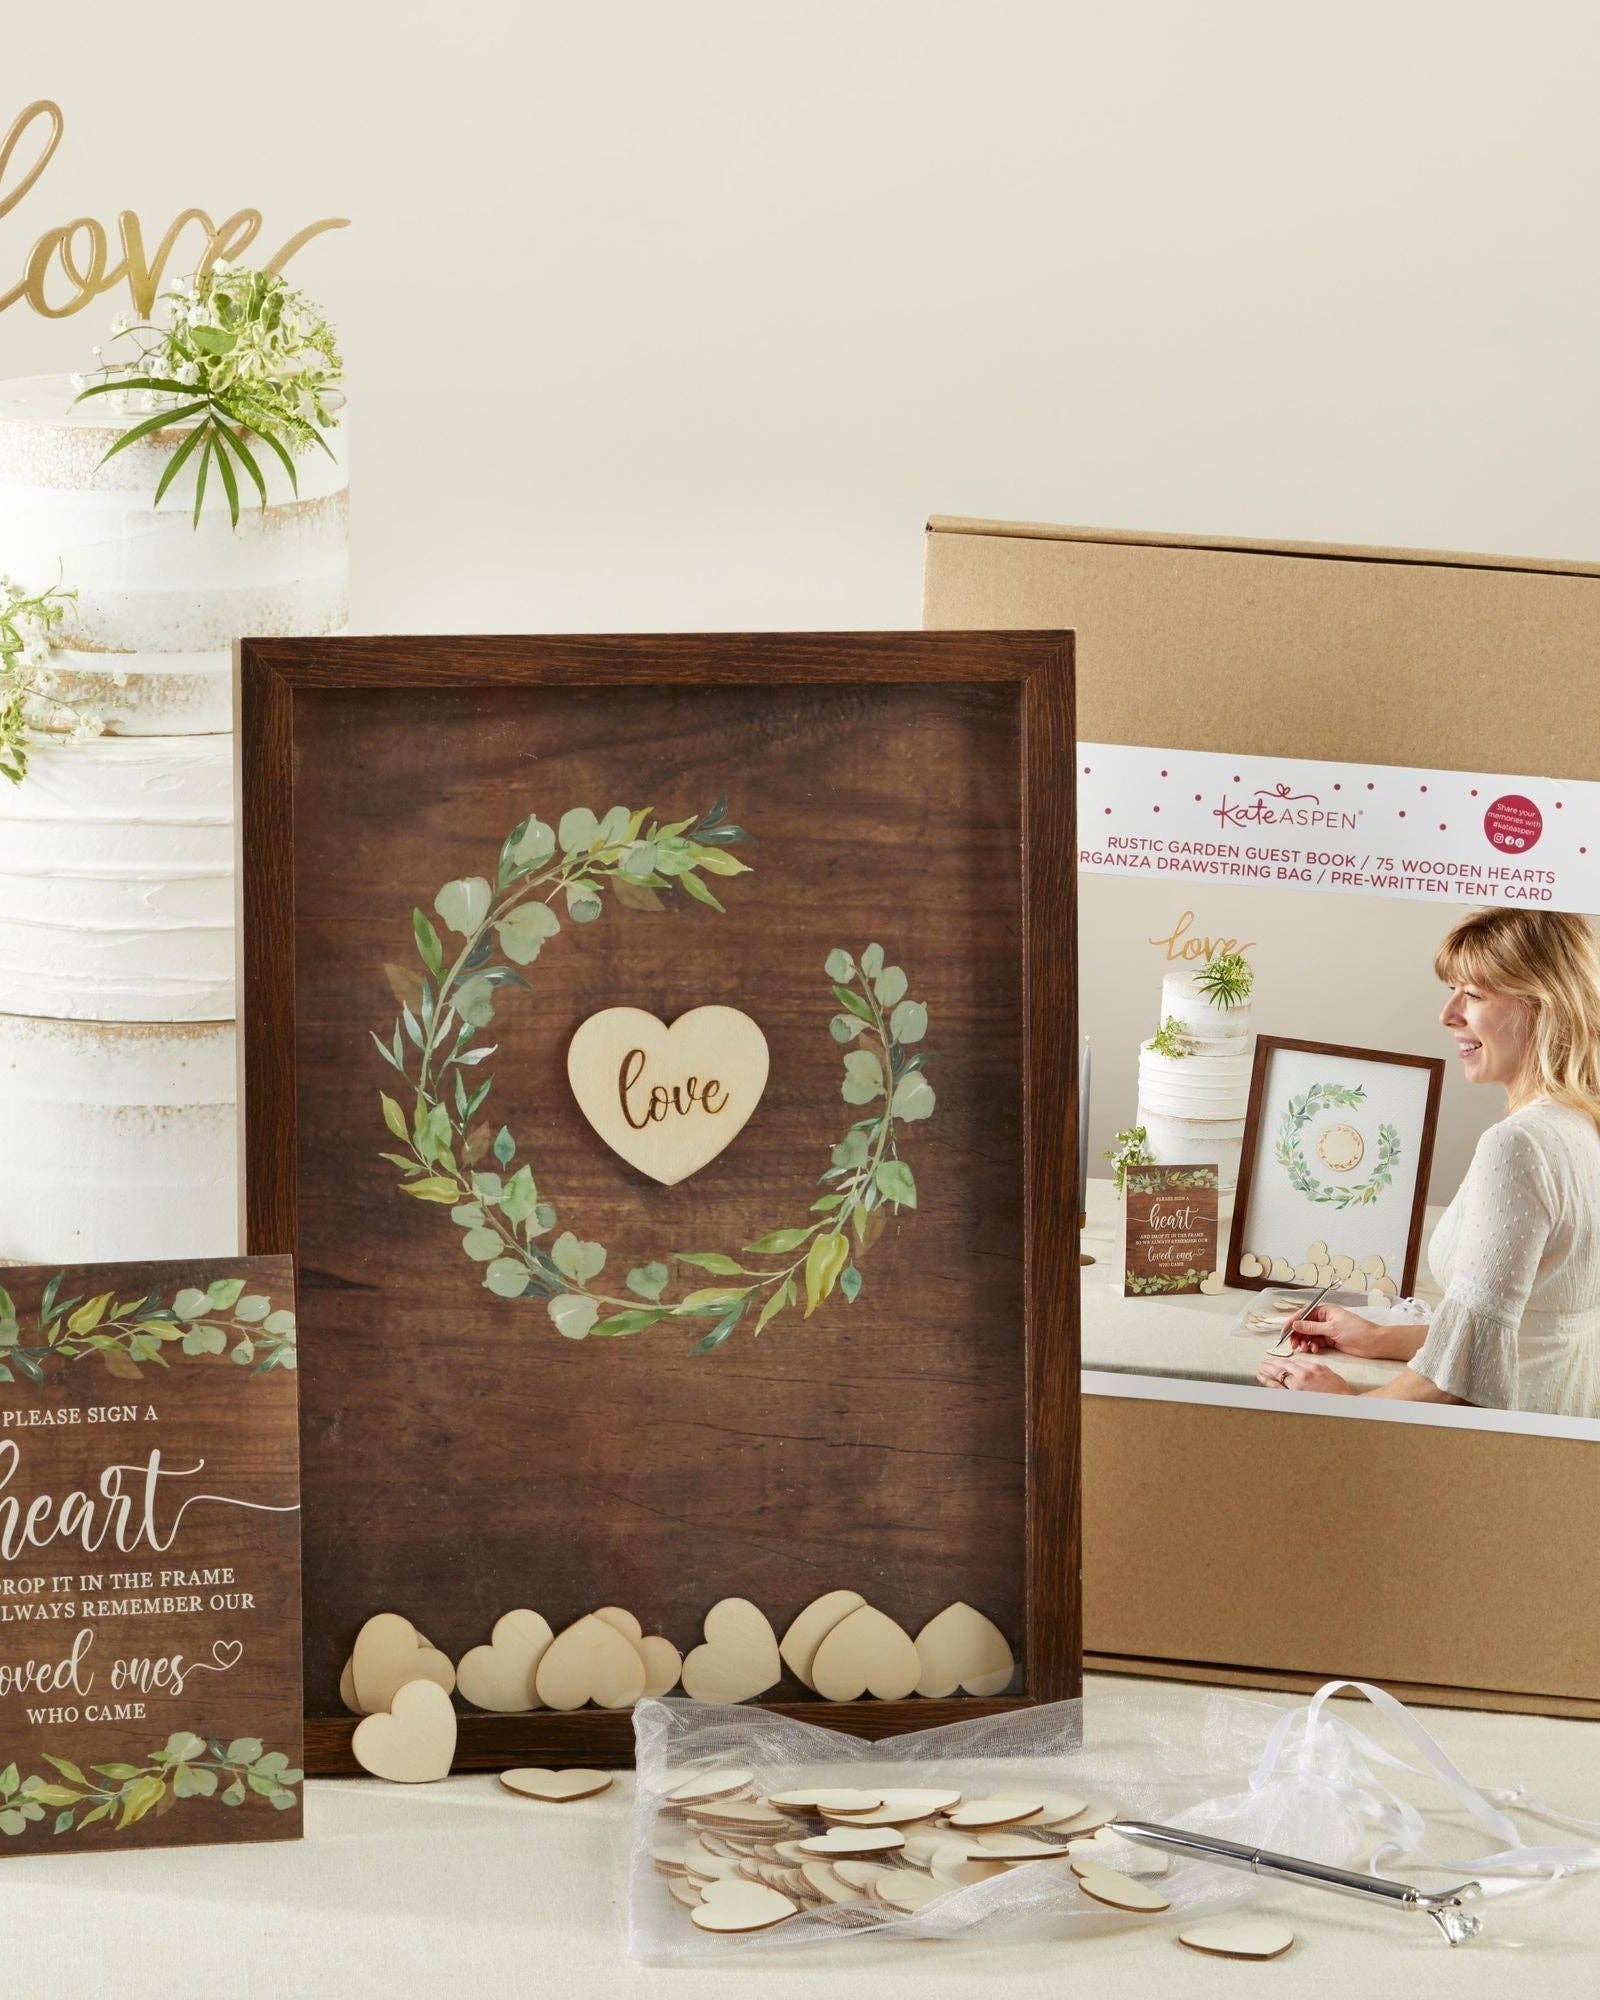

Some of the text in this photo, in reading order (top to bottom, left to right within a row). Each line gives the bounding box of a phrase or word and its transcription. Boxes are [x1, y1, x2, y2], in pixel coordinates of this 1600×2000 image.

[1487, 811, 1541, 828] memories with
[1497, 803, 1536, 818] Share your
[1108, 836, 1556, 884] RUSTIC GARDEN GUEST BOOK / 75 WOODEN HEARTS
[1157, 857, 1271, 878] DRAWSTRING
[1277, 867, 1312, 882] BAG
[1316, 869, 1326, 884] /
[1331, 871, 1449, 893] PRE-WRITTEN
[1455, 881, 1499, 897] TENT
[1504, 886, 1553, 901] CARD
[1149, 910, 1257, 961] love
[618, 1049, 729, 1129] love
[1147, 1203, 1202, 1231] heart
[1148, 1245, 1175, 1262] loved
[2, 1404, 159, 1427] PLEASE SIGN A
[0, 1567, 235, 1595] ROP IT IN THE FRAME
[81, 1597, 204, 1618] REMEMBER
[210, 1593, 256, 1611] OUR
[111, 1654, 186, 1695] ones
[26, 1703, 147, 1725] WHO CAME
